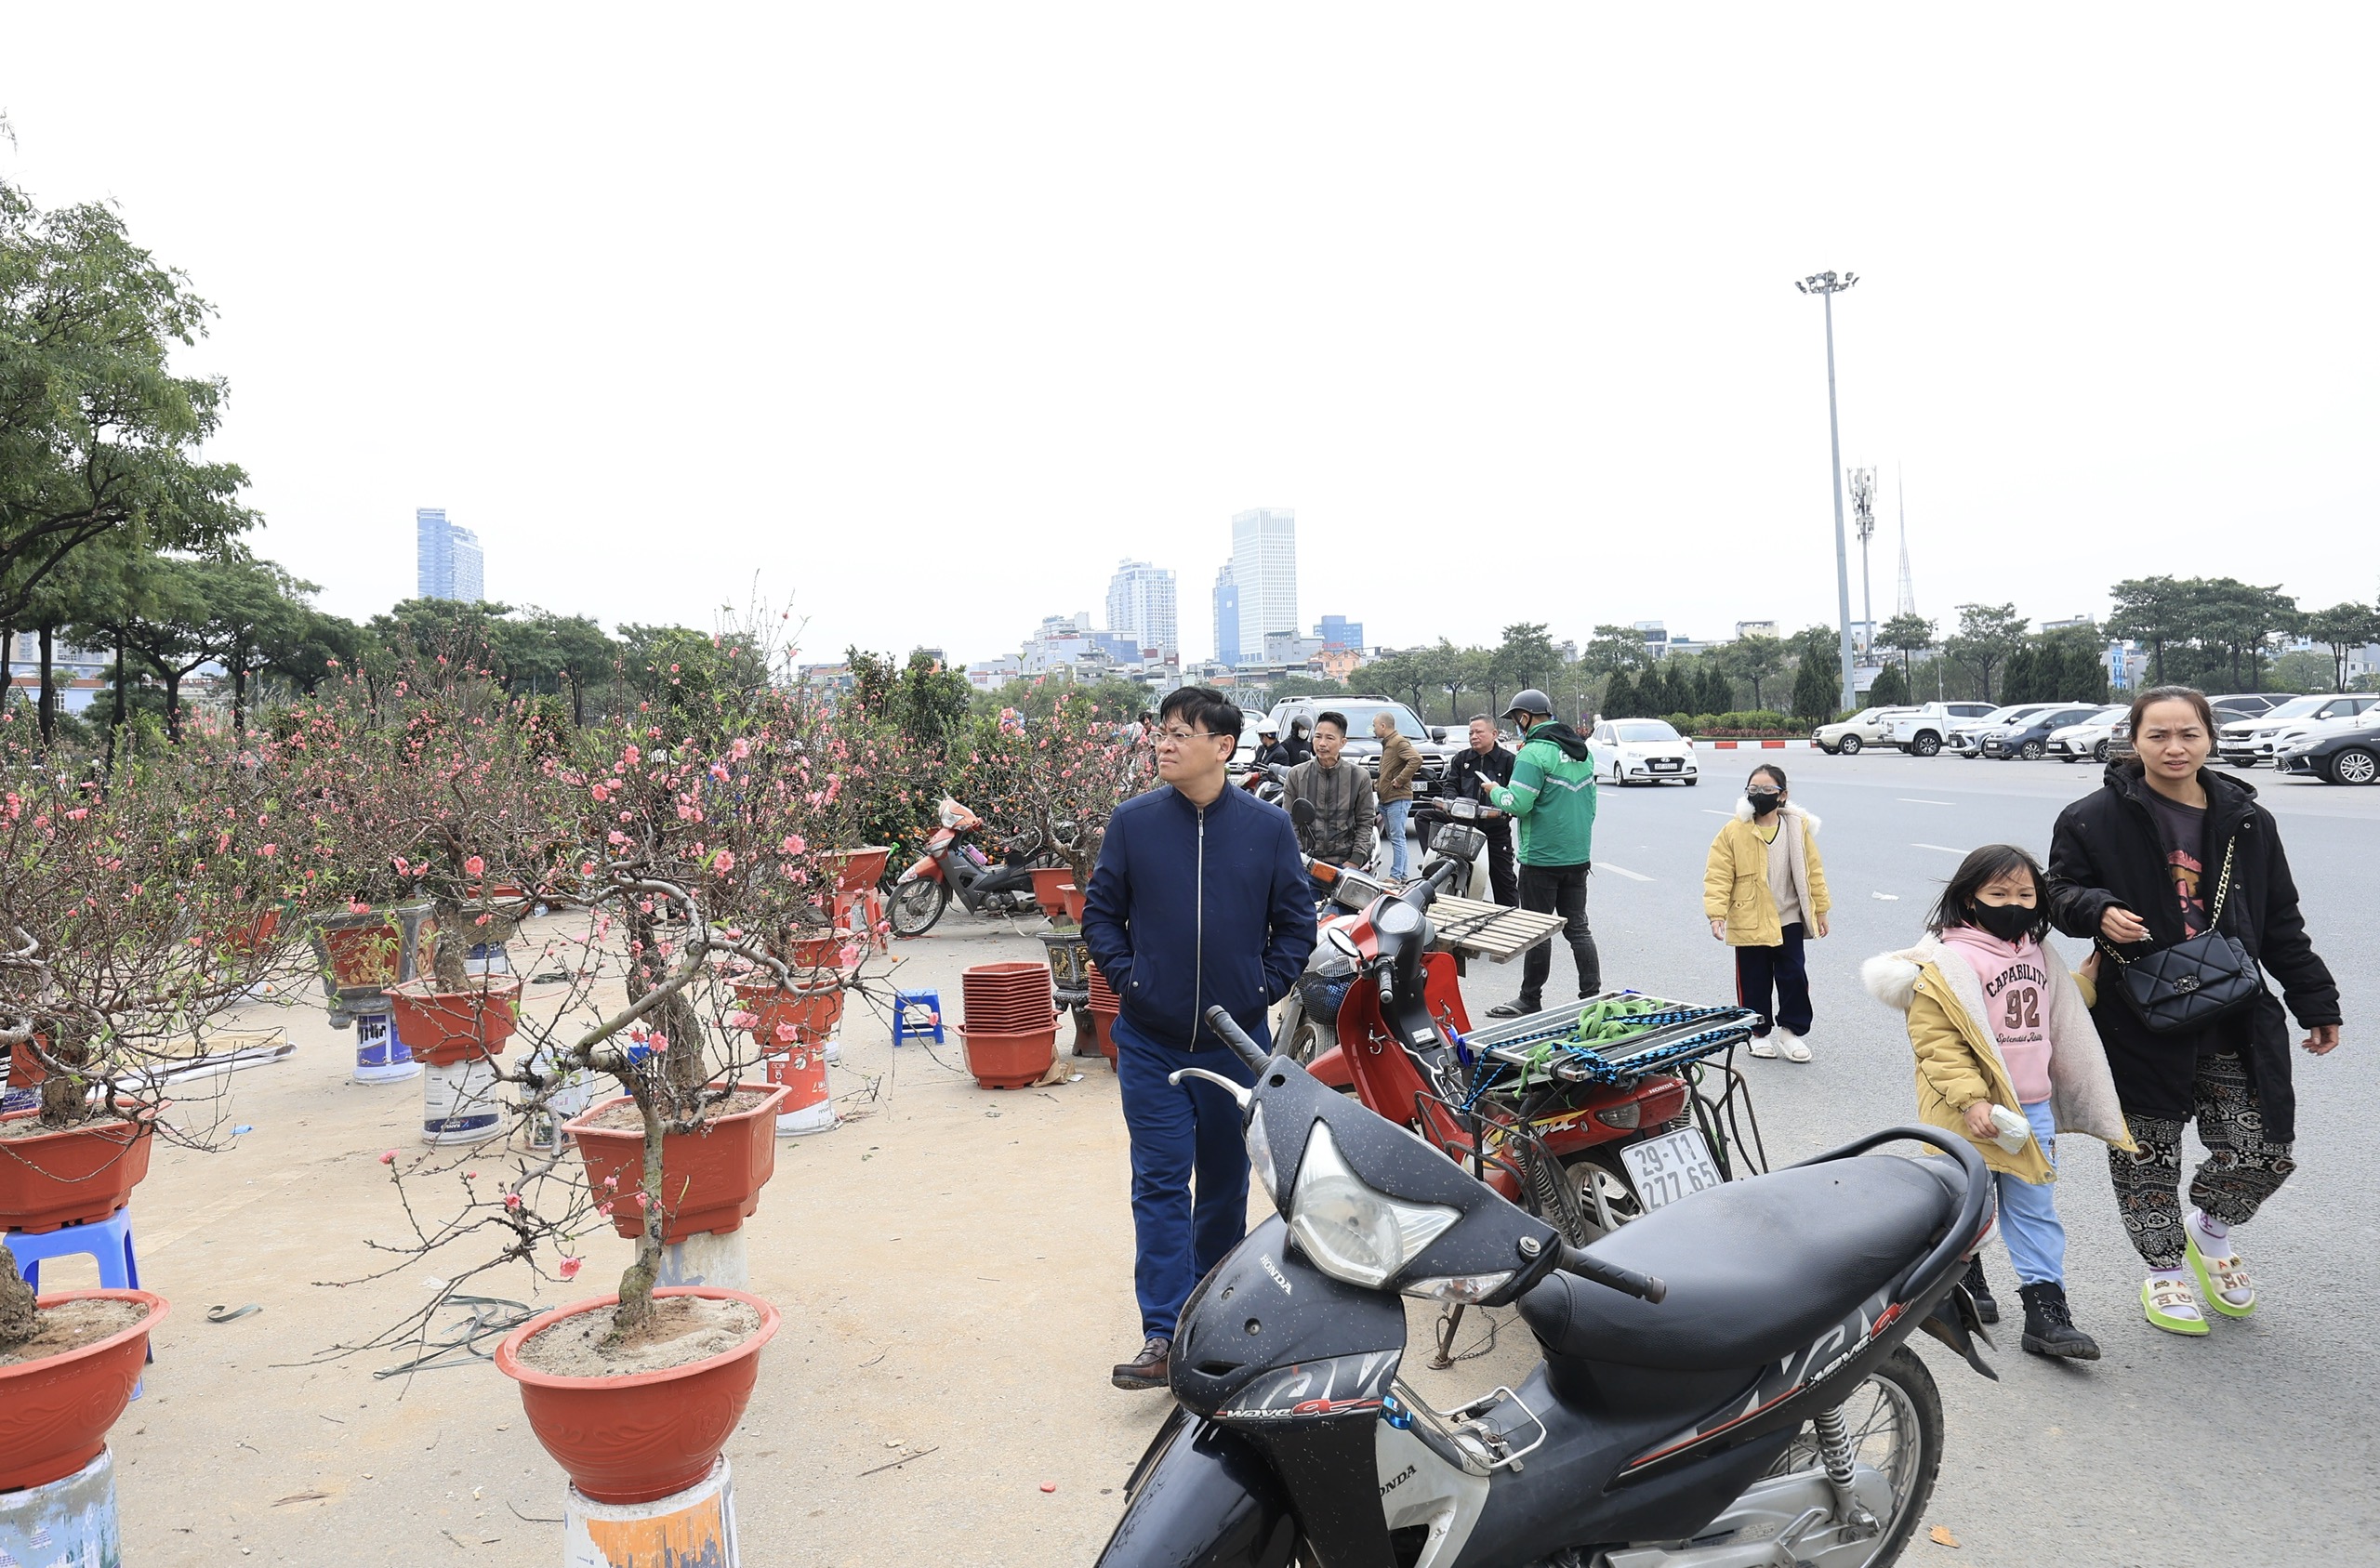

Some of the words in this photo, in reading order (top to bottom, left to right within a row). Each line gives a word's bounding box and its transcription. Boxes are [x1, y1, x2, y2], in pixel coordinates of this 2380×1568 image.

[1986, 963, 2048, 997] CAPABILITY
[2004, 987, 2041, 1030] 92
[1647, 1082, 1675, 1094] HONDA
[1634, 1133, 1698, 1178] 29-T1
[1260, 1254, 1292, 1296] HONDA
[1379, 1465, 1417, 1497] ONDA
